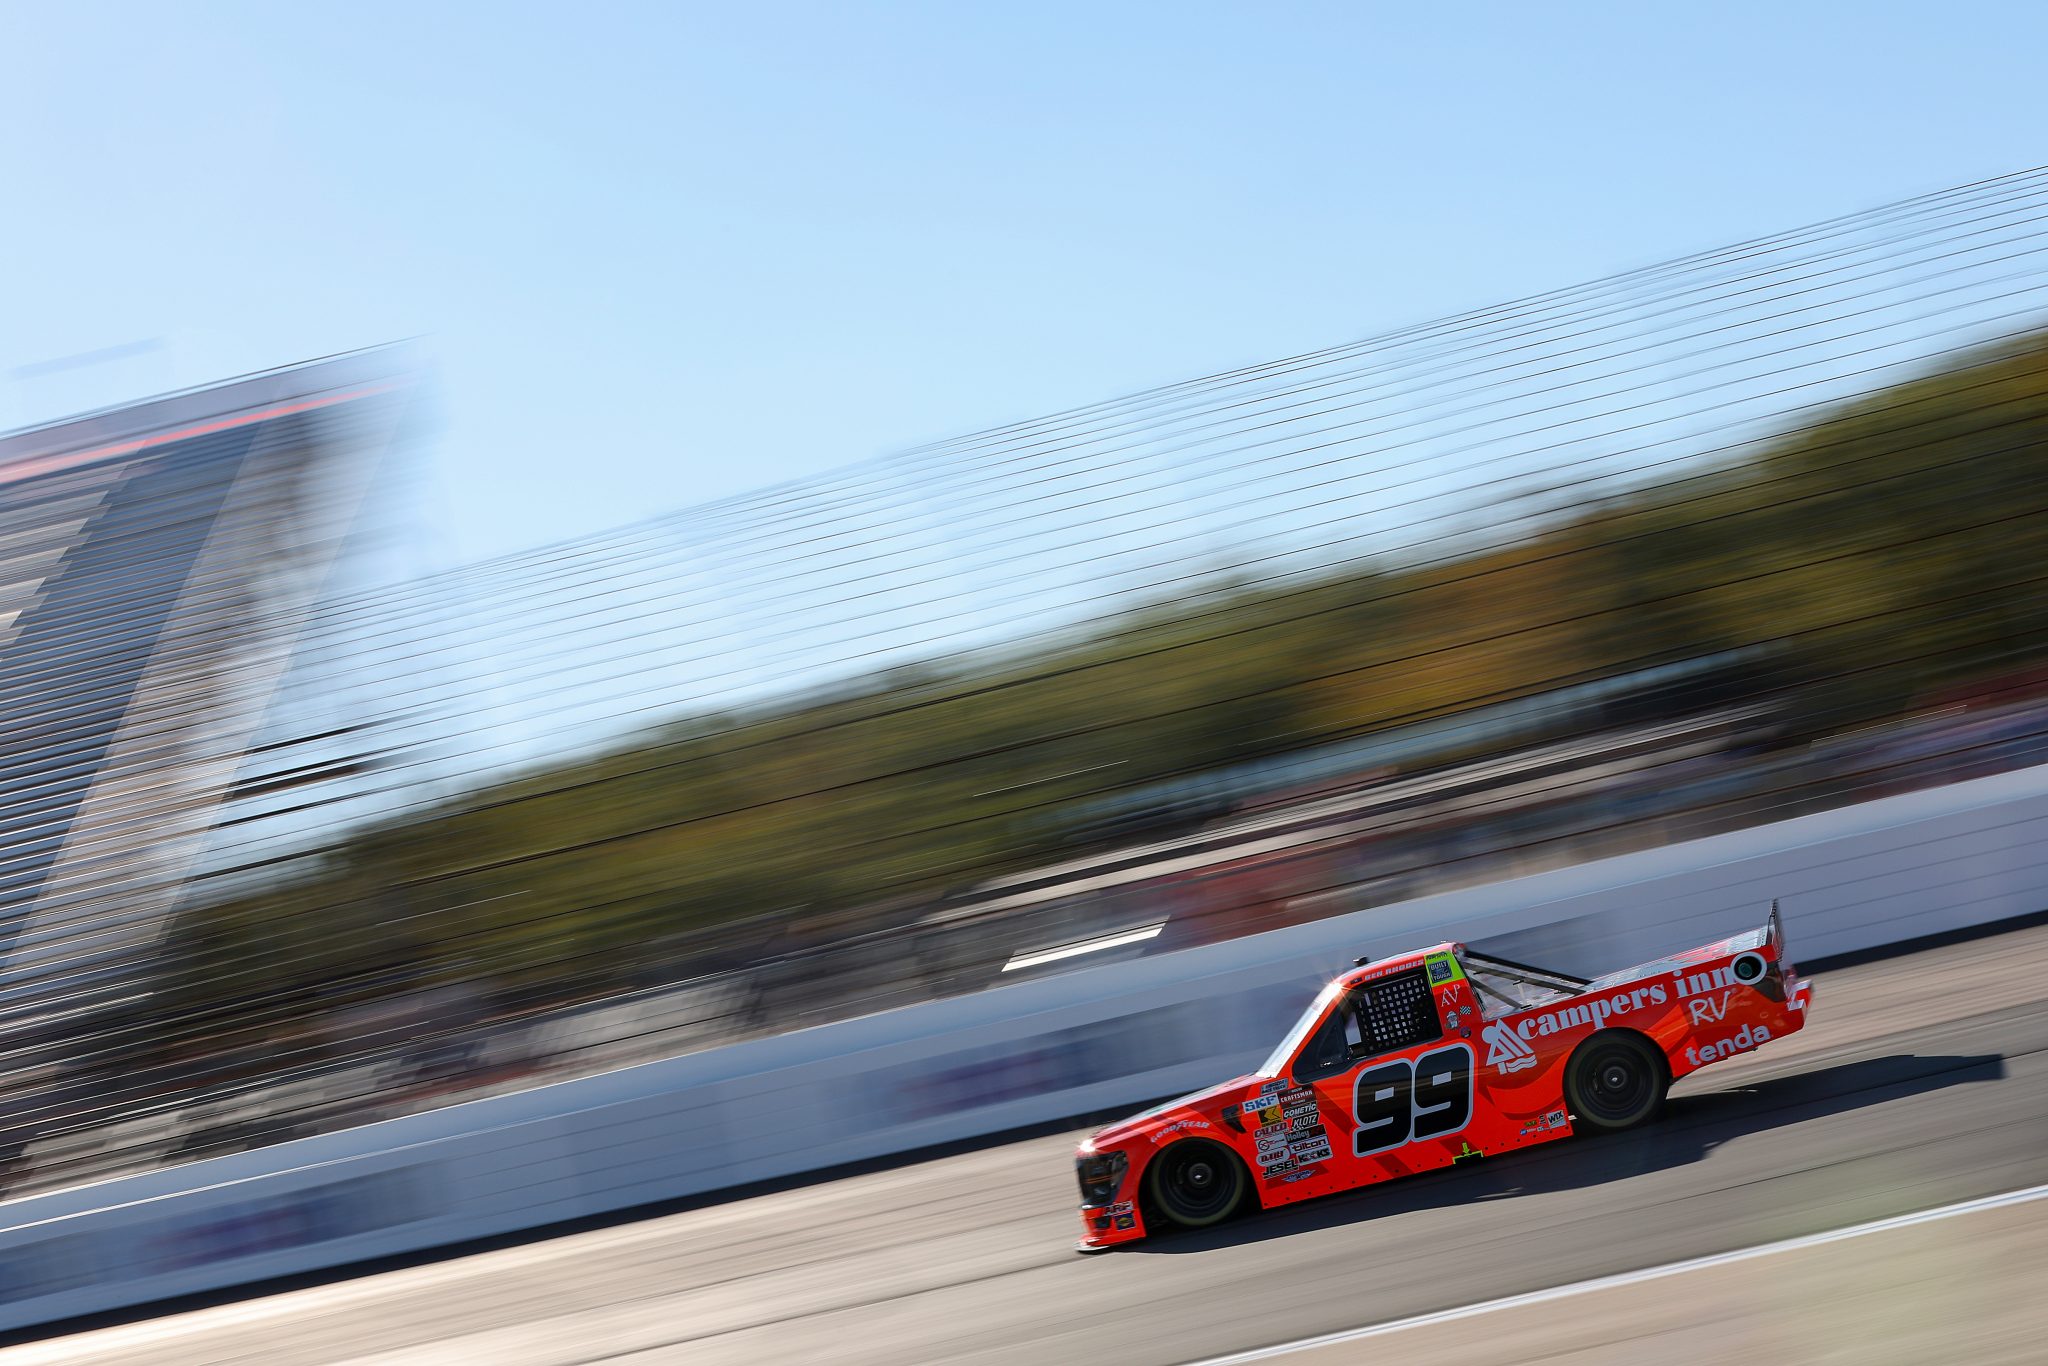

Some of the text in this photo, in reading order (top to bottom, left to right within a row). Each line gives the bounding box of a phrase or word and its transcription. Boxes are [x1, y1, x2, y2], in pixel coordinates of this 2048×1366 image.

[1517, 968, 1738, 1040] campers inn
[1688, 991, 1731, 1026] RV
[1685, 1023, 1772, 1066] tenda
[1244, 1095, 1277, 1112] SKF
[1280, 1090, 1313, 1103] CRAFTSMAN
[1353, 1043, 1475, 1157] 99
[1284, 1103, 1317, 1117] COMETIC
[1548, 1111, 1563, 1123] WIX
[1293, 1114, 1317, 1128] KLOTZ
[1286, 1130, 1310, 1142] Holley
[1292, 1139, 1327, 1152] tilton
[1263, 1159, 1299, 1175] JESEL
